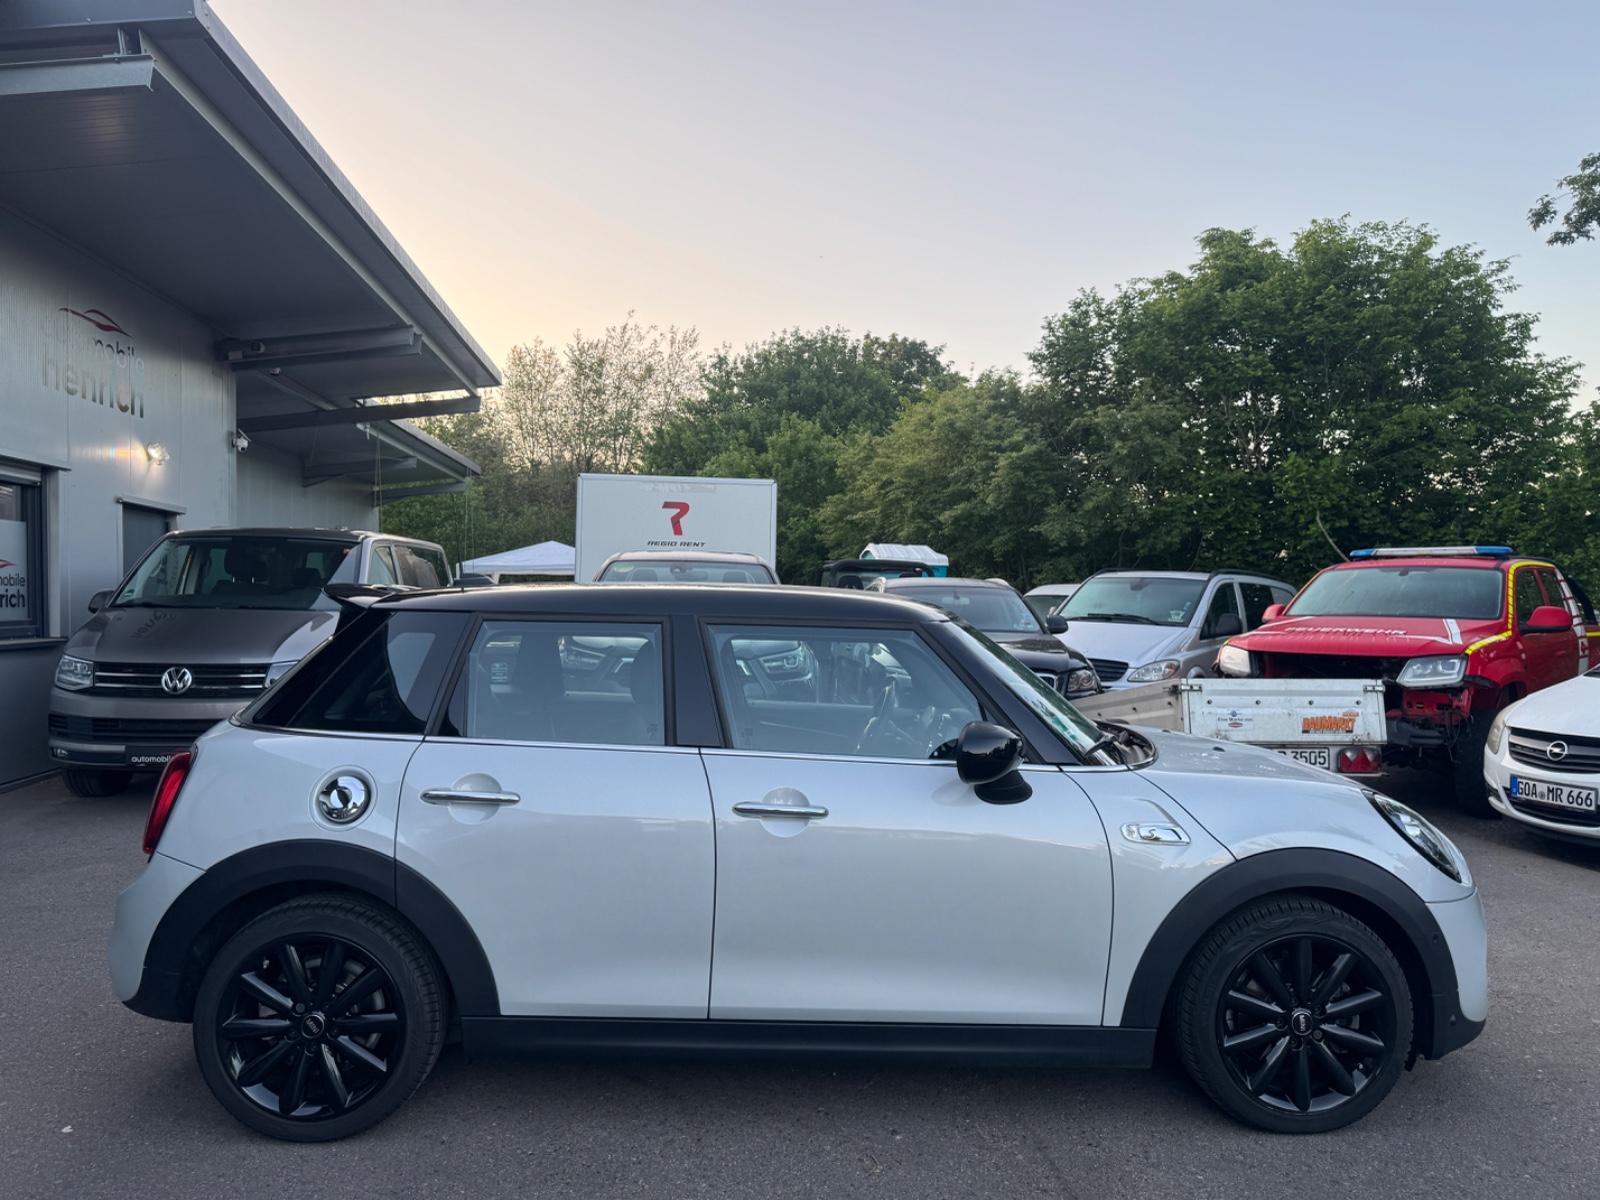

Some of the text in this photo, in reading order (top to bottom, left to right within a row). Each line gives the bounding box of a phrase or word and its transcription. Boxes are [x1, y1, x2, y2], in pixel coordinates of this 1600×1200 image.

[1290, 750, 1327, 766] 3505
[1517, 781, 1593, 808] GOA MR 666
